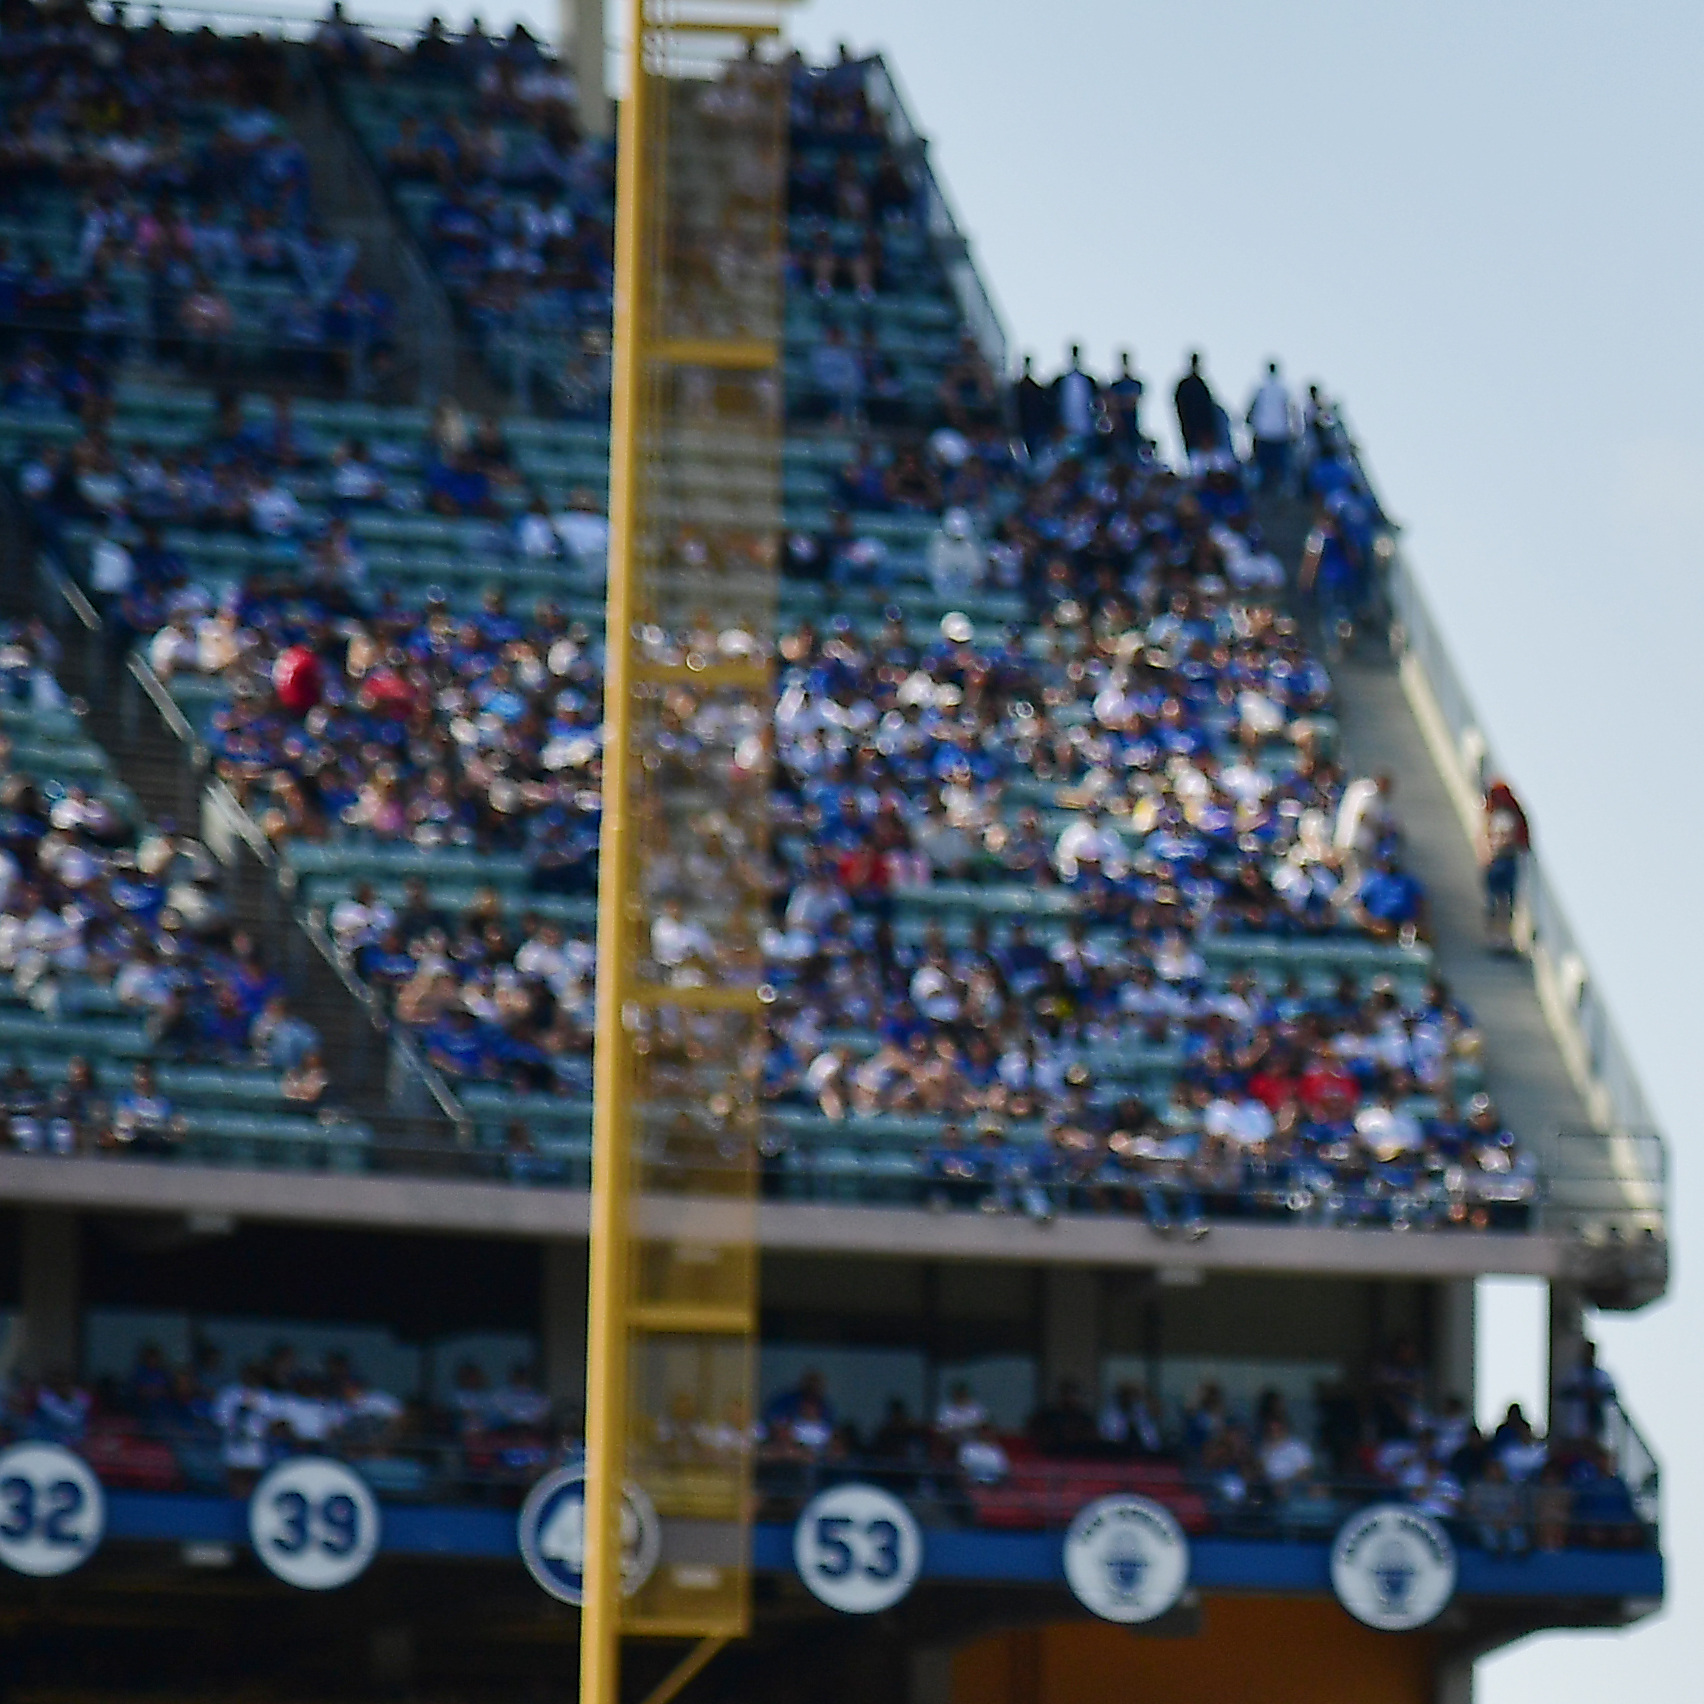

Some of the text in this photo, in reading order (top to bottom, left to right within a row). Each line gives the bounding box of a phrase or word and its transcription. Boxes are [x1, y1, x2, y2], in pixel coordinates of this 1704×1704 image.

[0, 1476, 83, 1543] 32
[272, 1490, 359, 1556] 39
[815, 1516, 900, 1580] 53
